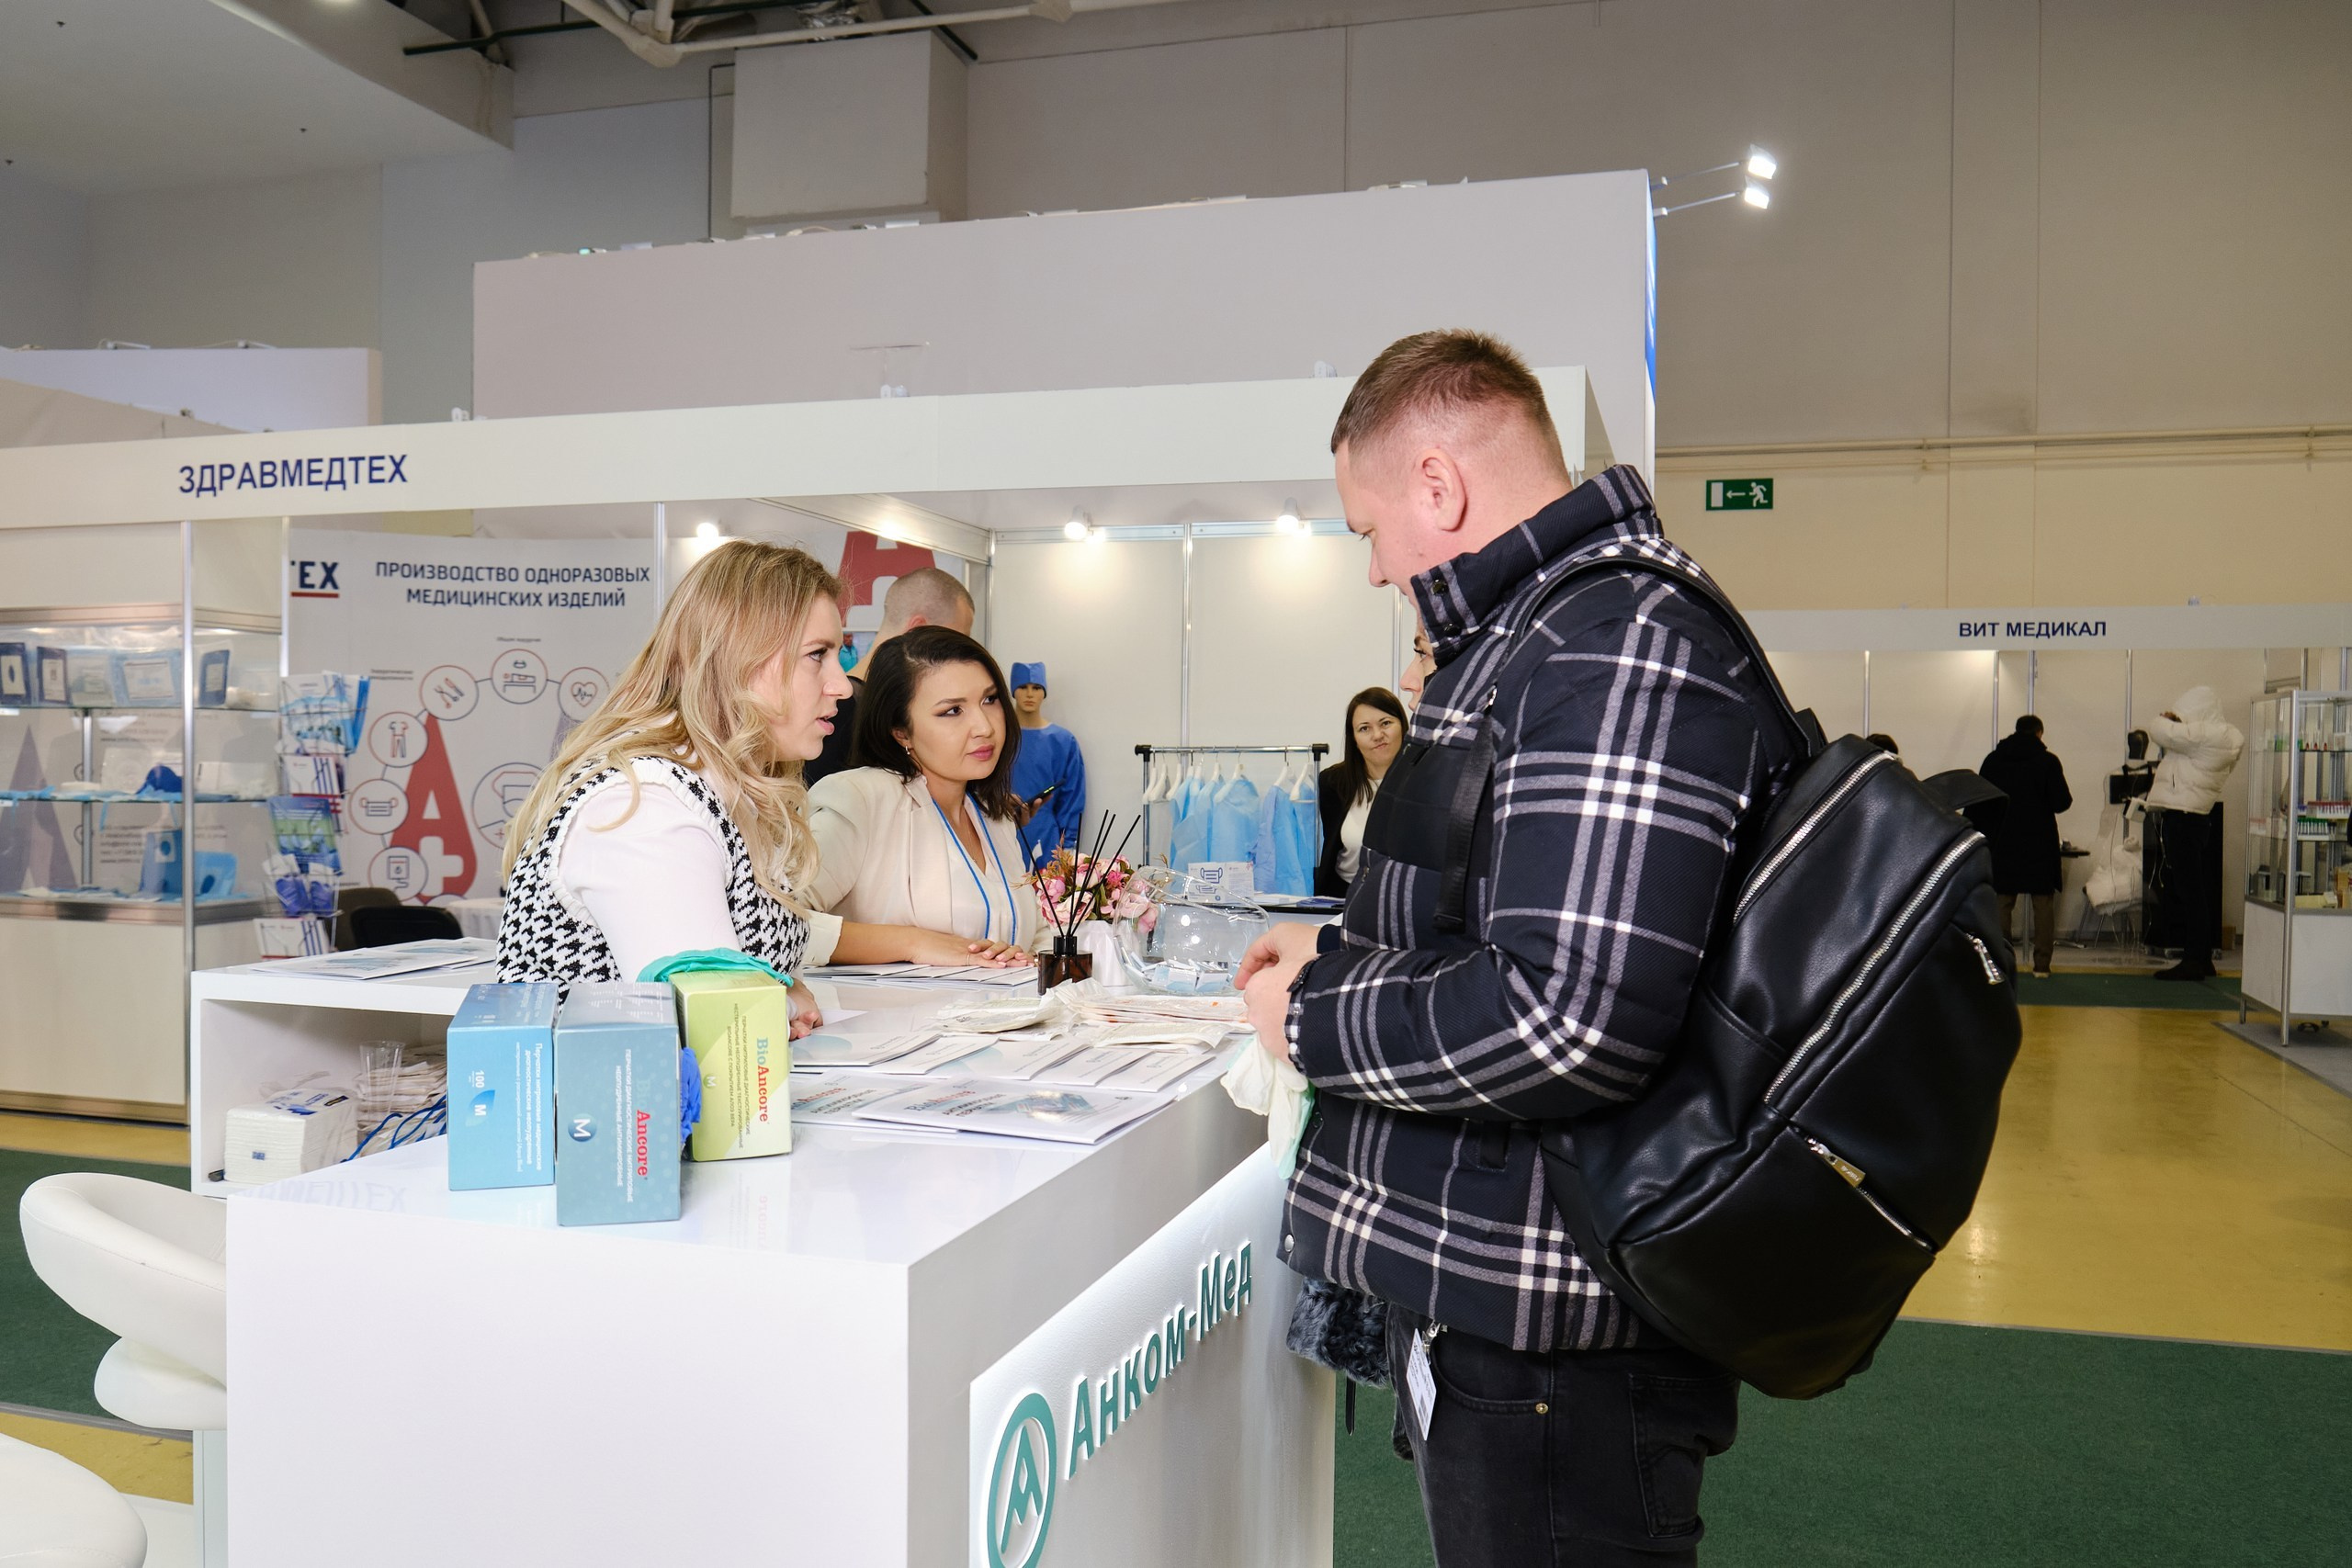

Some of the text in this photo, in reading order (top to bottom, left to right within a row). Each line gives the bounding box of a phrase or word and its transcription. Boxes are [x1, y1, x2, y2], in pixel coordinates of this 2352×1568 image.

[179, 454, 408, 497] ЗДРАВМЕДТЕХ
[290, 560, 339, 590] ЕХ
[376, 561, 650, 584] ПРОИЗВОДСТВО ОДНОРАЗОВЫХ
[406, 588, 626, 609] МЕДИЦИНСКИХ ИЗДЕЛИЙ
[1959, 621, 2107, 639] ВИТ МЕДИКАЛ
[535, 1043, 543, 1078] Перчатки
[475, 1070, 484, 1089] 100
[756, 1037, 770, 1122] BioAncore
[535, 1078, 543, 1122] нитриловые
[525, 1111, 533, 1165] неопудренные
[573, 1118, 591, 1138] M
[1065, 1240, 1252, 1481] Анком-Мед
